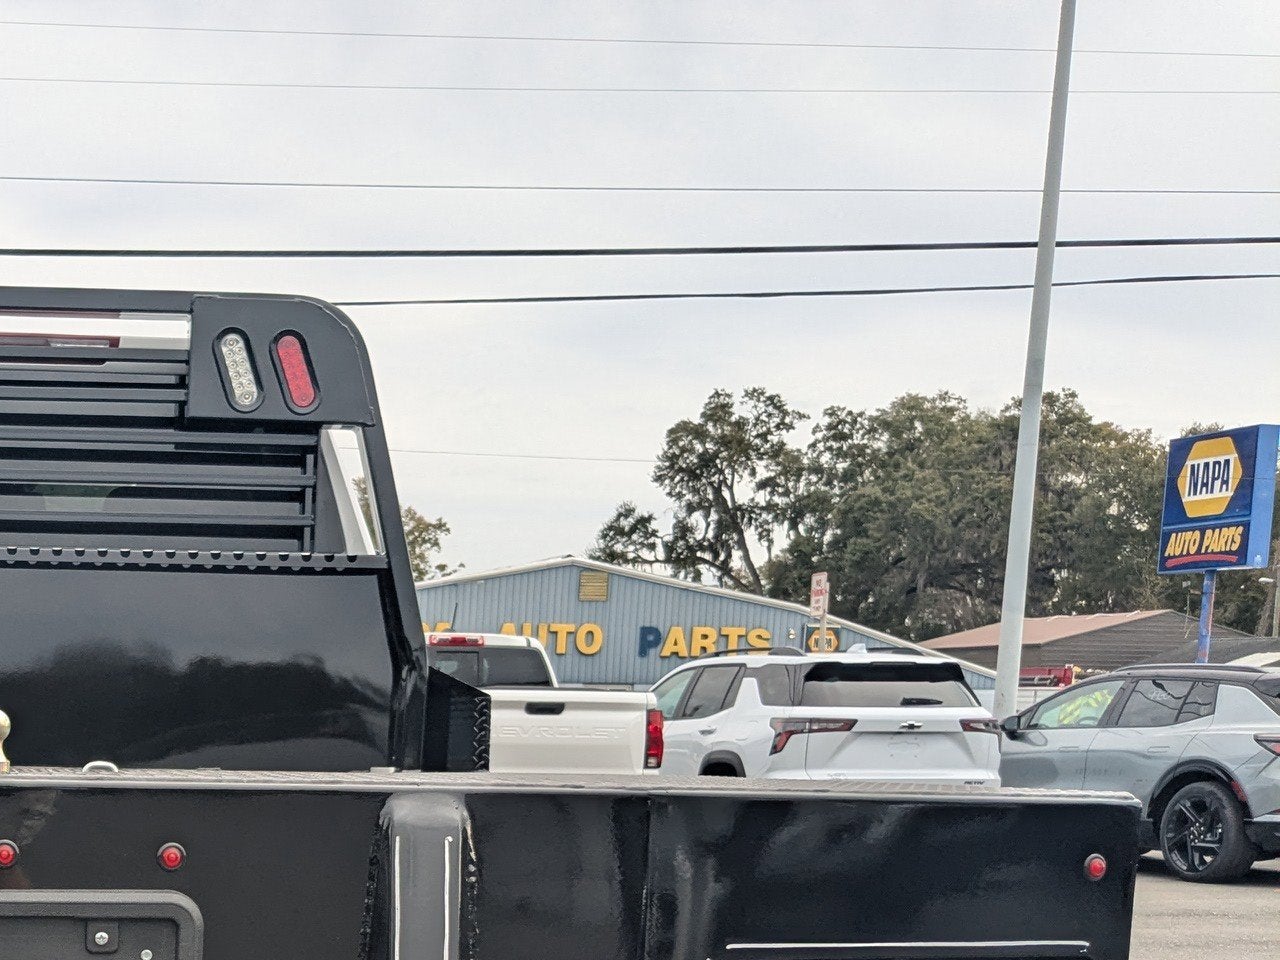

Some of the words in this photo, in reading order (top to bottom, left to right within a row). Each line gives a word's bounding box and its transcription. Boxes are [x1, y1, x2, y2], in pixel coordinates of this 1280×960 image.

[1187, 458, 1231, 498] NAPA
[1164, 530, 1201, 557] AUTO
[1201, 526, 1245, 554] PARTS
[637, 625, 773, 659] PARTS
[812, 637, 833, 650] NPA
